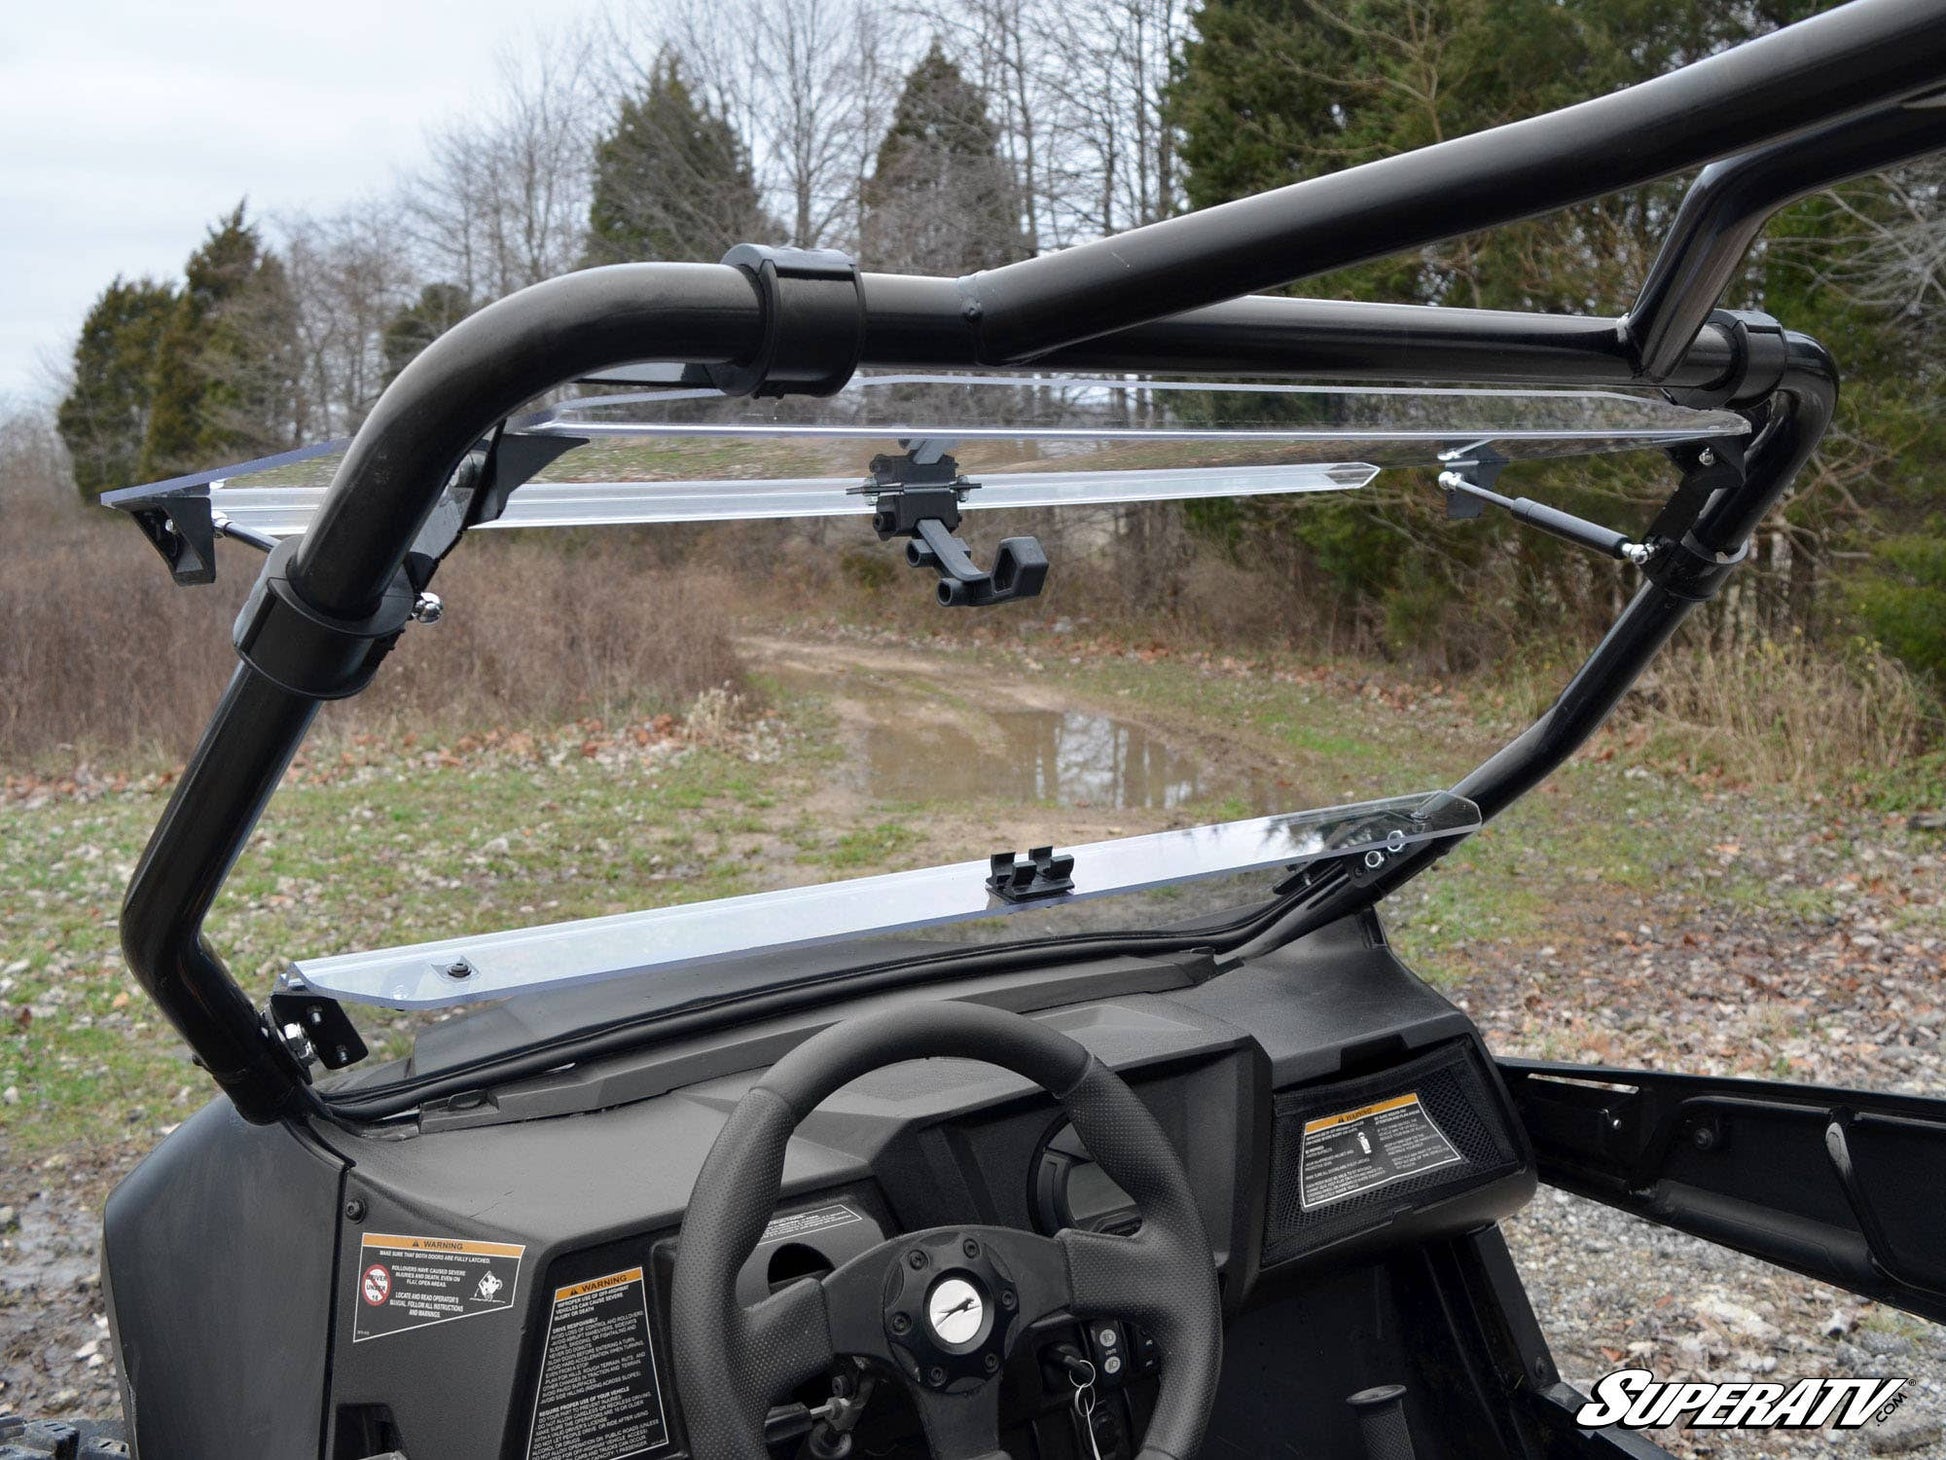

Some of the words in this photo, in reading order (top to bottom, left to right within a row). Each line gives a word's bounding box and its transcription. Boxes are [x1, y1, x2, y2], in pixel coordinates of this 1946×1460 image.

[424, 1240, 463, 1250] WARNING
[582, 1275, 627, 1292] WARNING
[433, 1304, 464, 1312] INSTRUCTIONS
[556, 1305, 578, 1314] VEHICLES
[605, 1293, 623, 1301] SEVERE
[539, 1407, 559, 1417] REQUIRE
[560, 1401, 579, 1411] PROPER
[610, 1386, 630, 1396] VEHICLE
